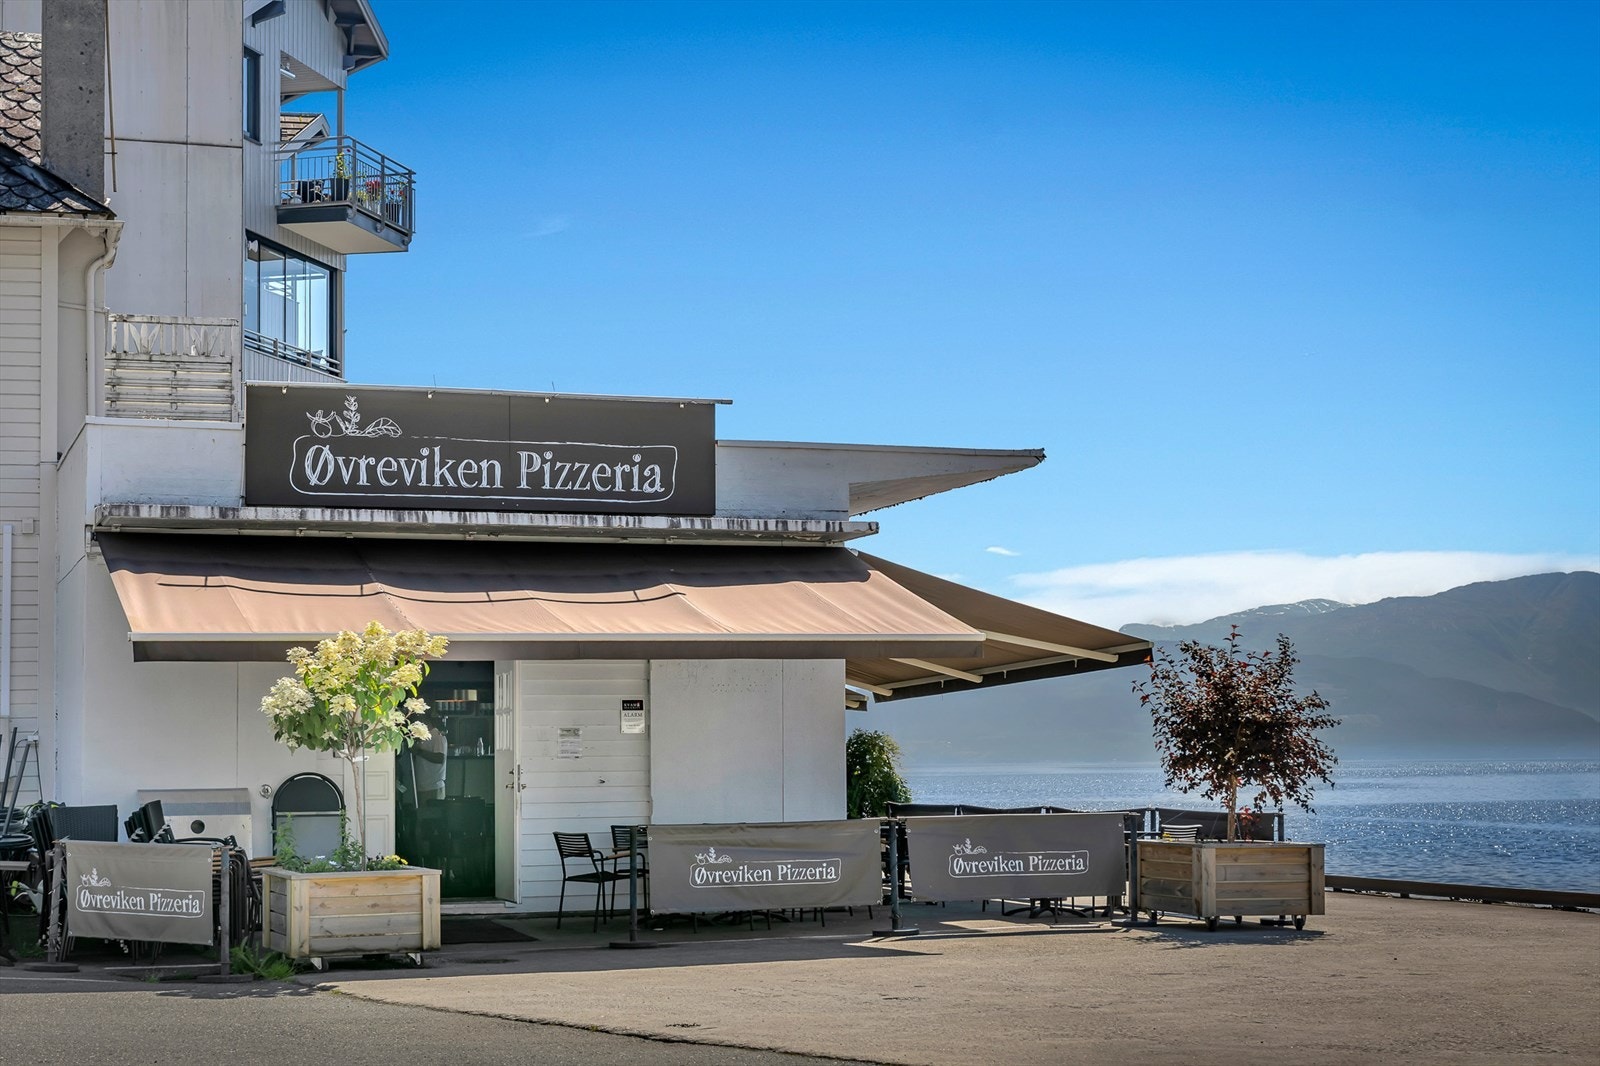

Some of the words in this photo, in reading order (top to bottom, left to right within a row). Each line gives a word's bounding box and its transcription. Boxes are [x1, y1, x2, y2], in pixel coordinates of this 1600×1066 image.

[304, 444, 504, 489] Øvreviken
[516, 449, 665, 494] Pizzeria
[694, 864, 773, 885] Øvreviken
[777, 862, 837, 881] Pizzeria
[953, 855, 1024, 874] Øvreviken
[1028, 854, 1085, 872] Pizzeria
[80, 889, 146, 911] Øvreviken
[149, 892, 201, 914] Pizzeria
